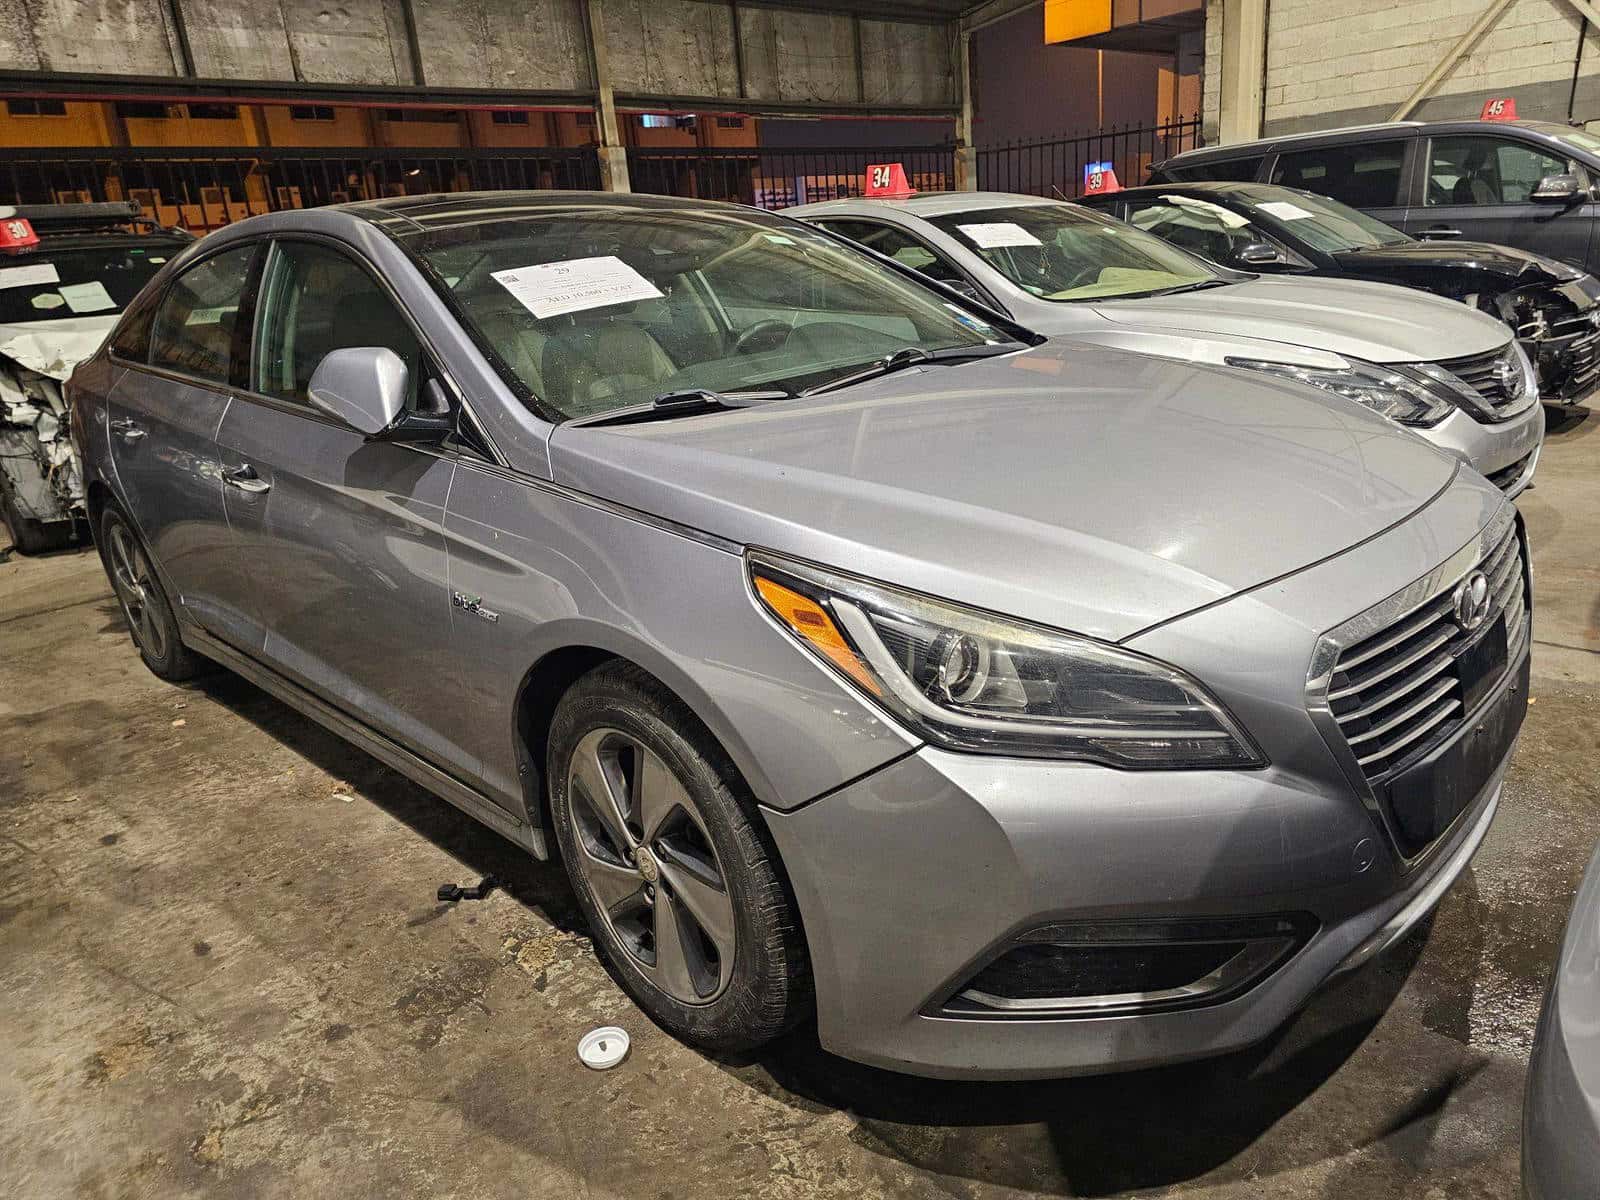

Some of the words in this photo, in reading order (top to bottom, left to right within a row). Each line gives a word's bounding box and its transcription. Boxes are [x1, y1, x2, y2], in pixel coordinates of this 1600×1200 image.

[1488, 100, 1504, 115] 45
[873, 166, 890, 188] 34
[1090, 173, 1102, 190] 39
[8, 220, 29, 239] 30
